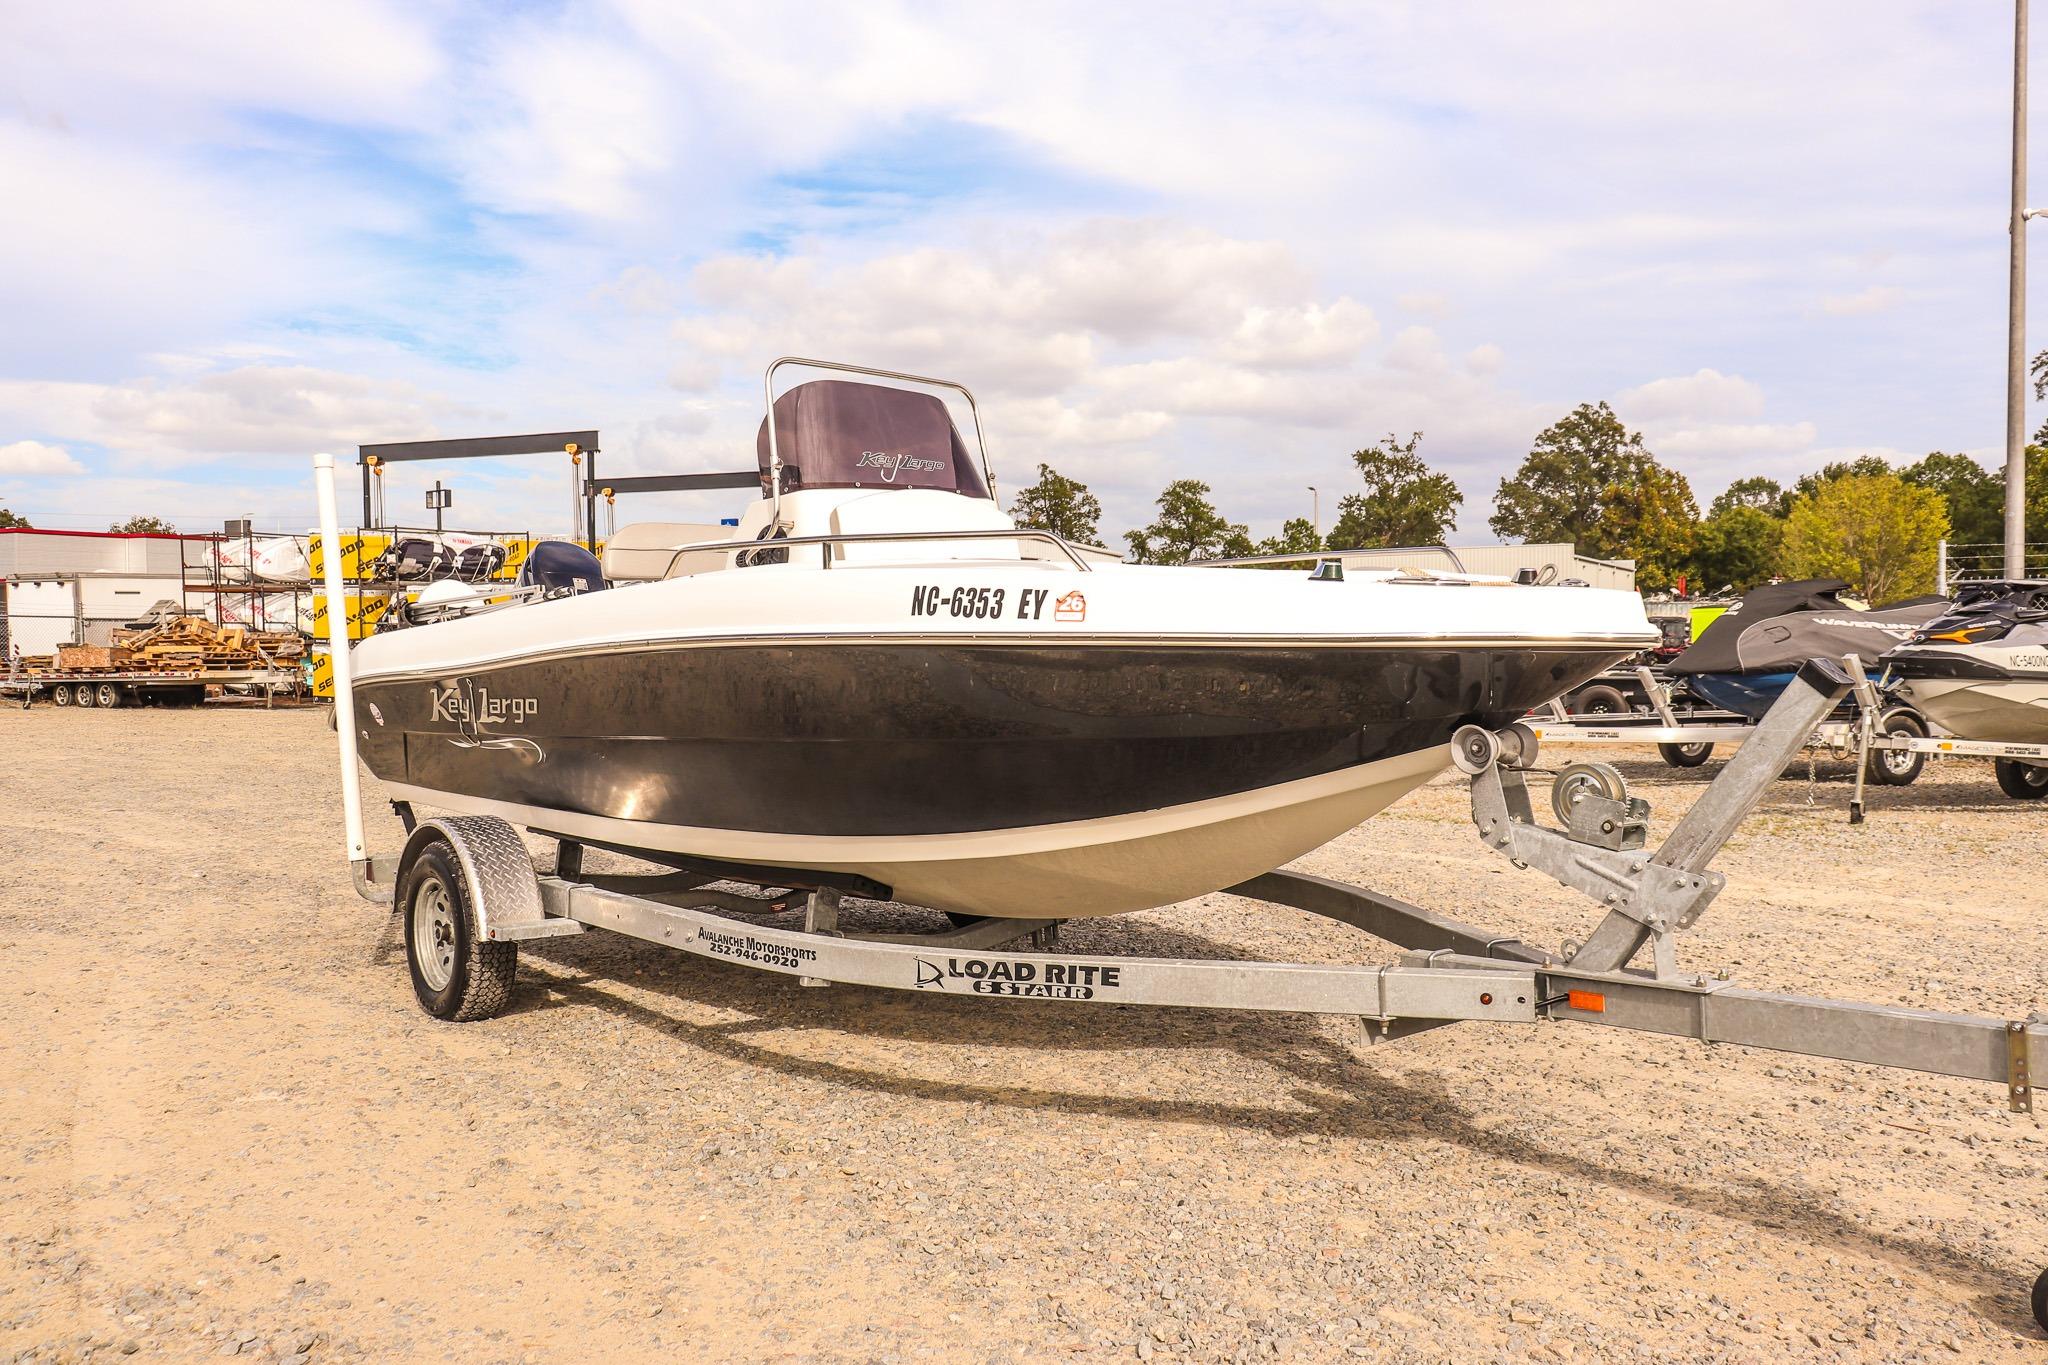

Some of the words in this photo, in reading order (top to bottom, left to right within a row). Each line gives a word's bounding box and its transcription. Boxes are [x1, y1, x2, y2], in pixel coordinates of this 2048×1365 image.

[856, 451, 896, 468] Key
[899, 455, 945, 472] Largo
[911, 585, 1006, 619] NC-6353
[1017, 588, 1049, 620] EY
[1058, 596, 1084, 611] 26
[429, 688, 470, 723] Key
[476, 687, 538, 724] Largo
[709, 942, 799, 968] 252-946-0920
[948, 958, 1037, 982] LOAD
[1045, 963, 1121, 988] RITE
[979, 981, 993, 993] 5
[999, 982, 1087, 999] STARR
